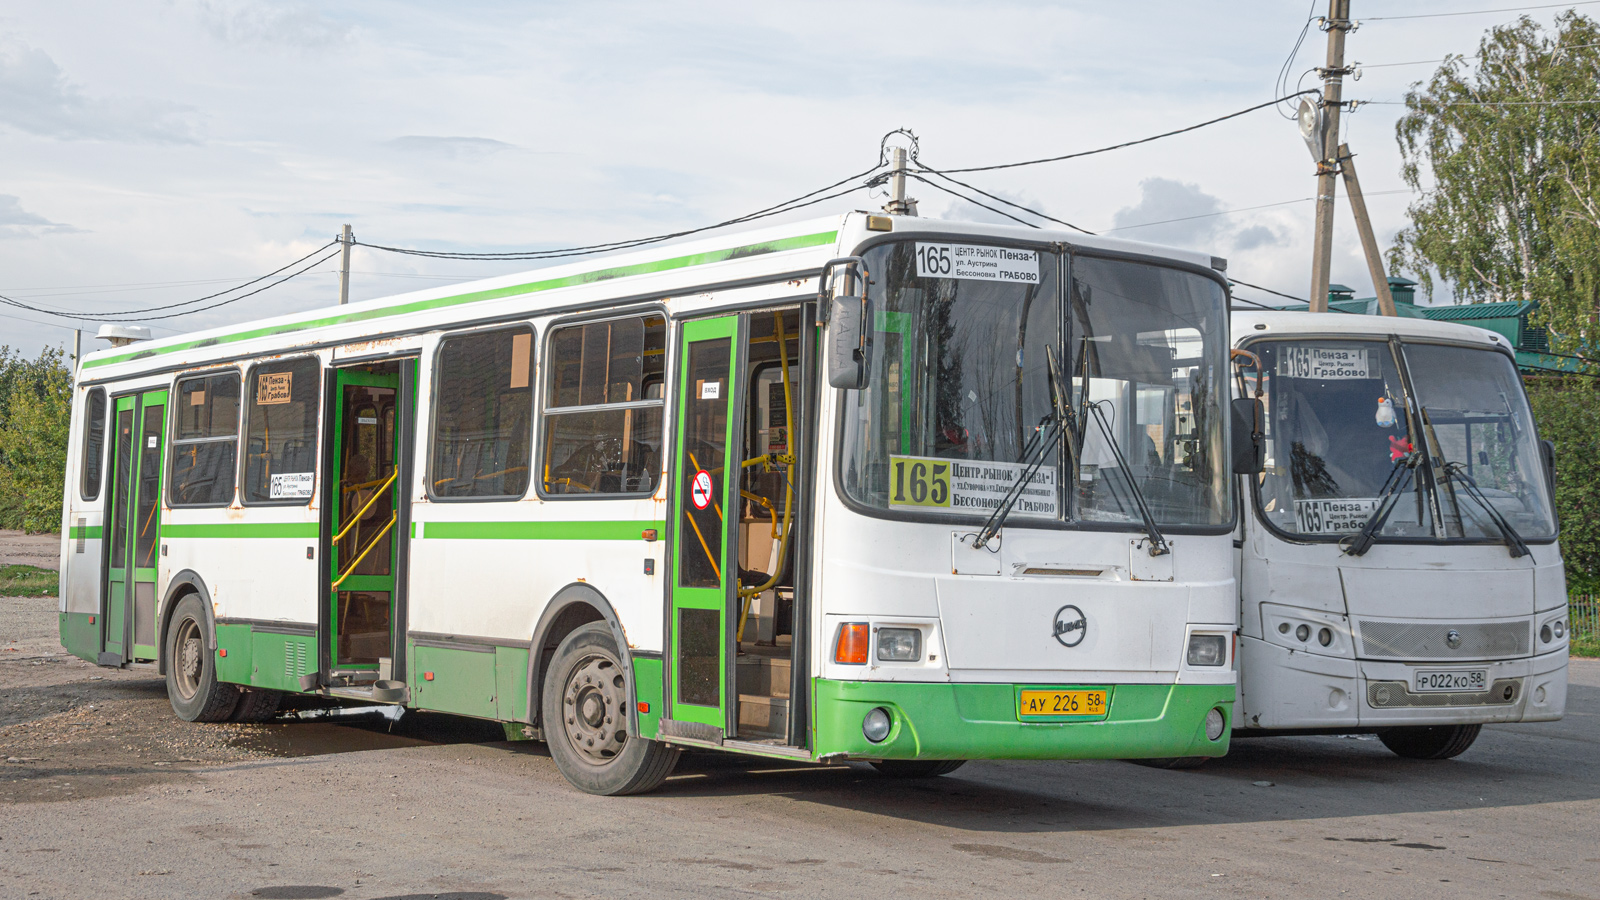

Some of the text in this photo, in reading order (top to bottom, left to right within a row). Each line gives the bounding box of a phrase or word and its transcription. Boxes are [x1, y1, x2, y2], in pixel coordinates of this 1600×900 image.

[918, 246, 951, 274] 165
[955, 247, 1037, 261] ЦЕНТР. РЫНОК Пенза-1
[967, 259, 998, 268] Аустрина
[956, 269, 1037, 281] Бессоновка ГРАБОВО
[1313, 350, 1348, 360] Пенза
[1290, 348, 1309, 377] 165
[1313, 367, 1366, 377] Грабово
[271, 476, 283, 496] 165
[894, 462, 948, 504] 165
[1323, 502, 1361, 512] Пенза
[1298, 502, 1321, 532] 165
[1325, 520, 1366, 531] Грабо
[1470, 672, 1482, 683] 58
[1029, 693, 1101, 711] АУ 226 58
